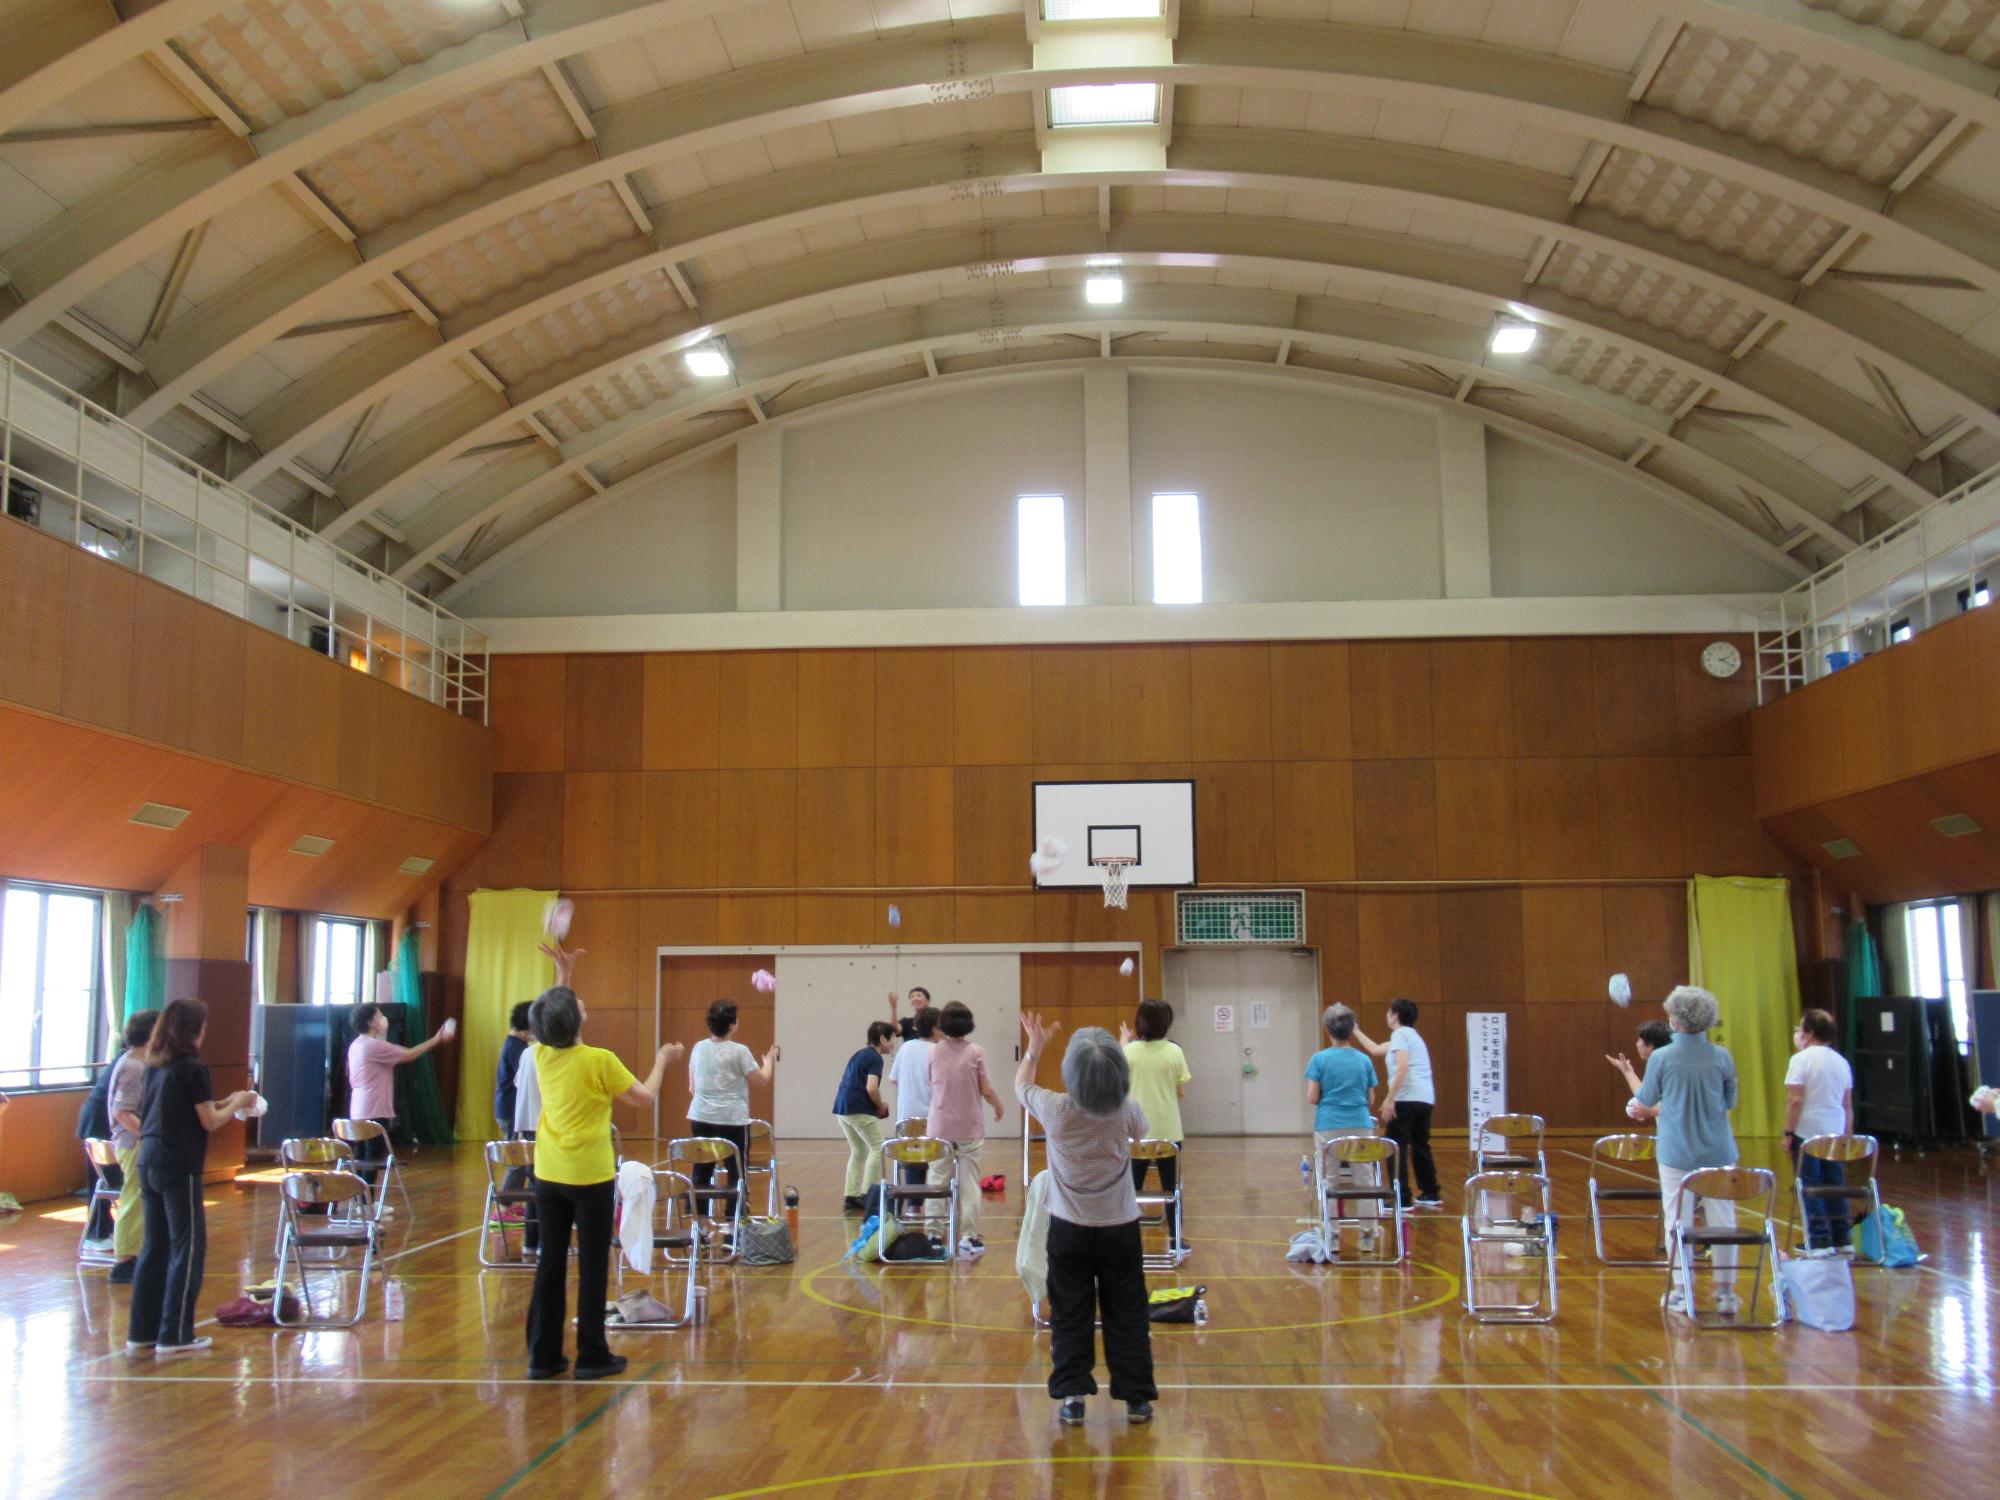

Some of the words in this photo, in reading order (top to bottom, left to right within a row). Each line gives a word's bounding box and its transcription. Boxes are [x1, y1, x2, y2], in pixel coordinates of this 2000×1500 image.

[1491, 1016, 1501, 1092] ロコモ予防教室
